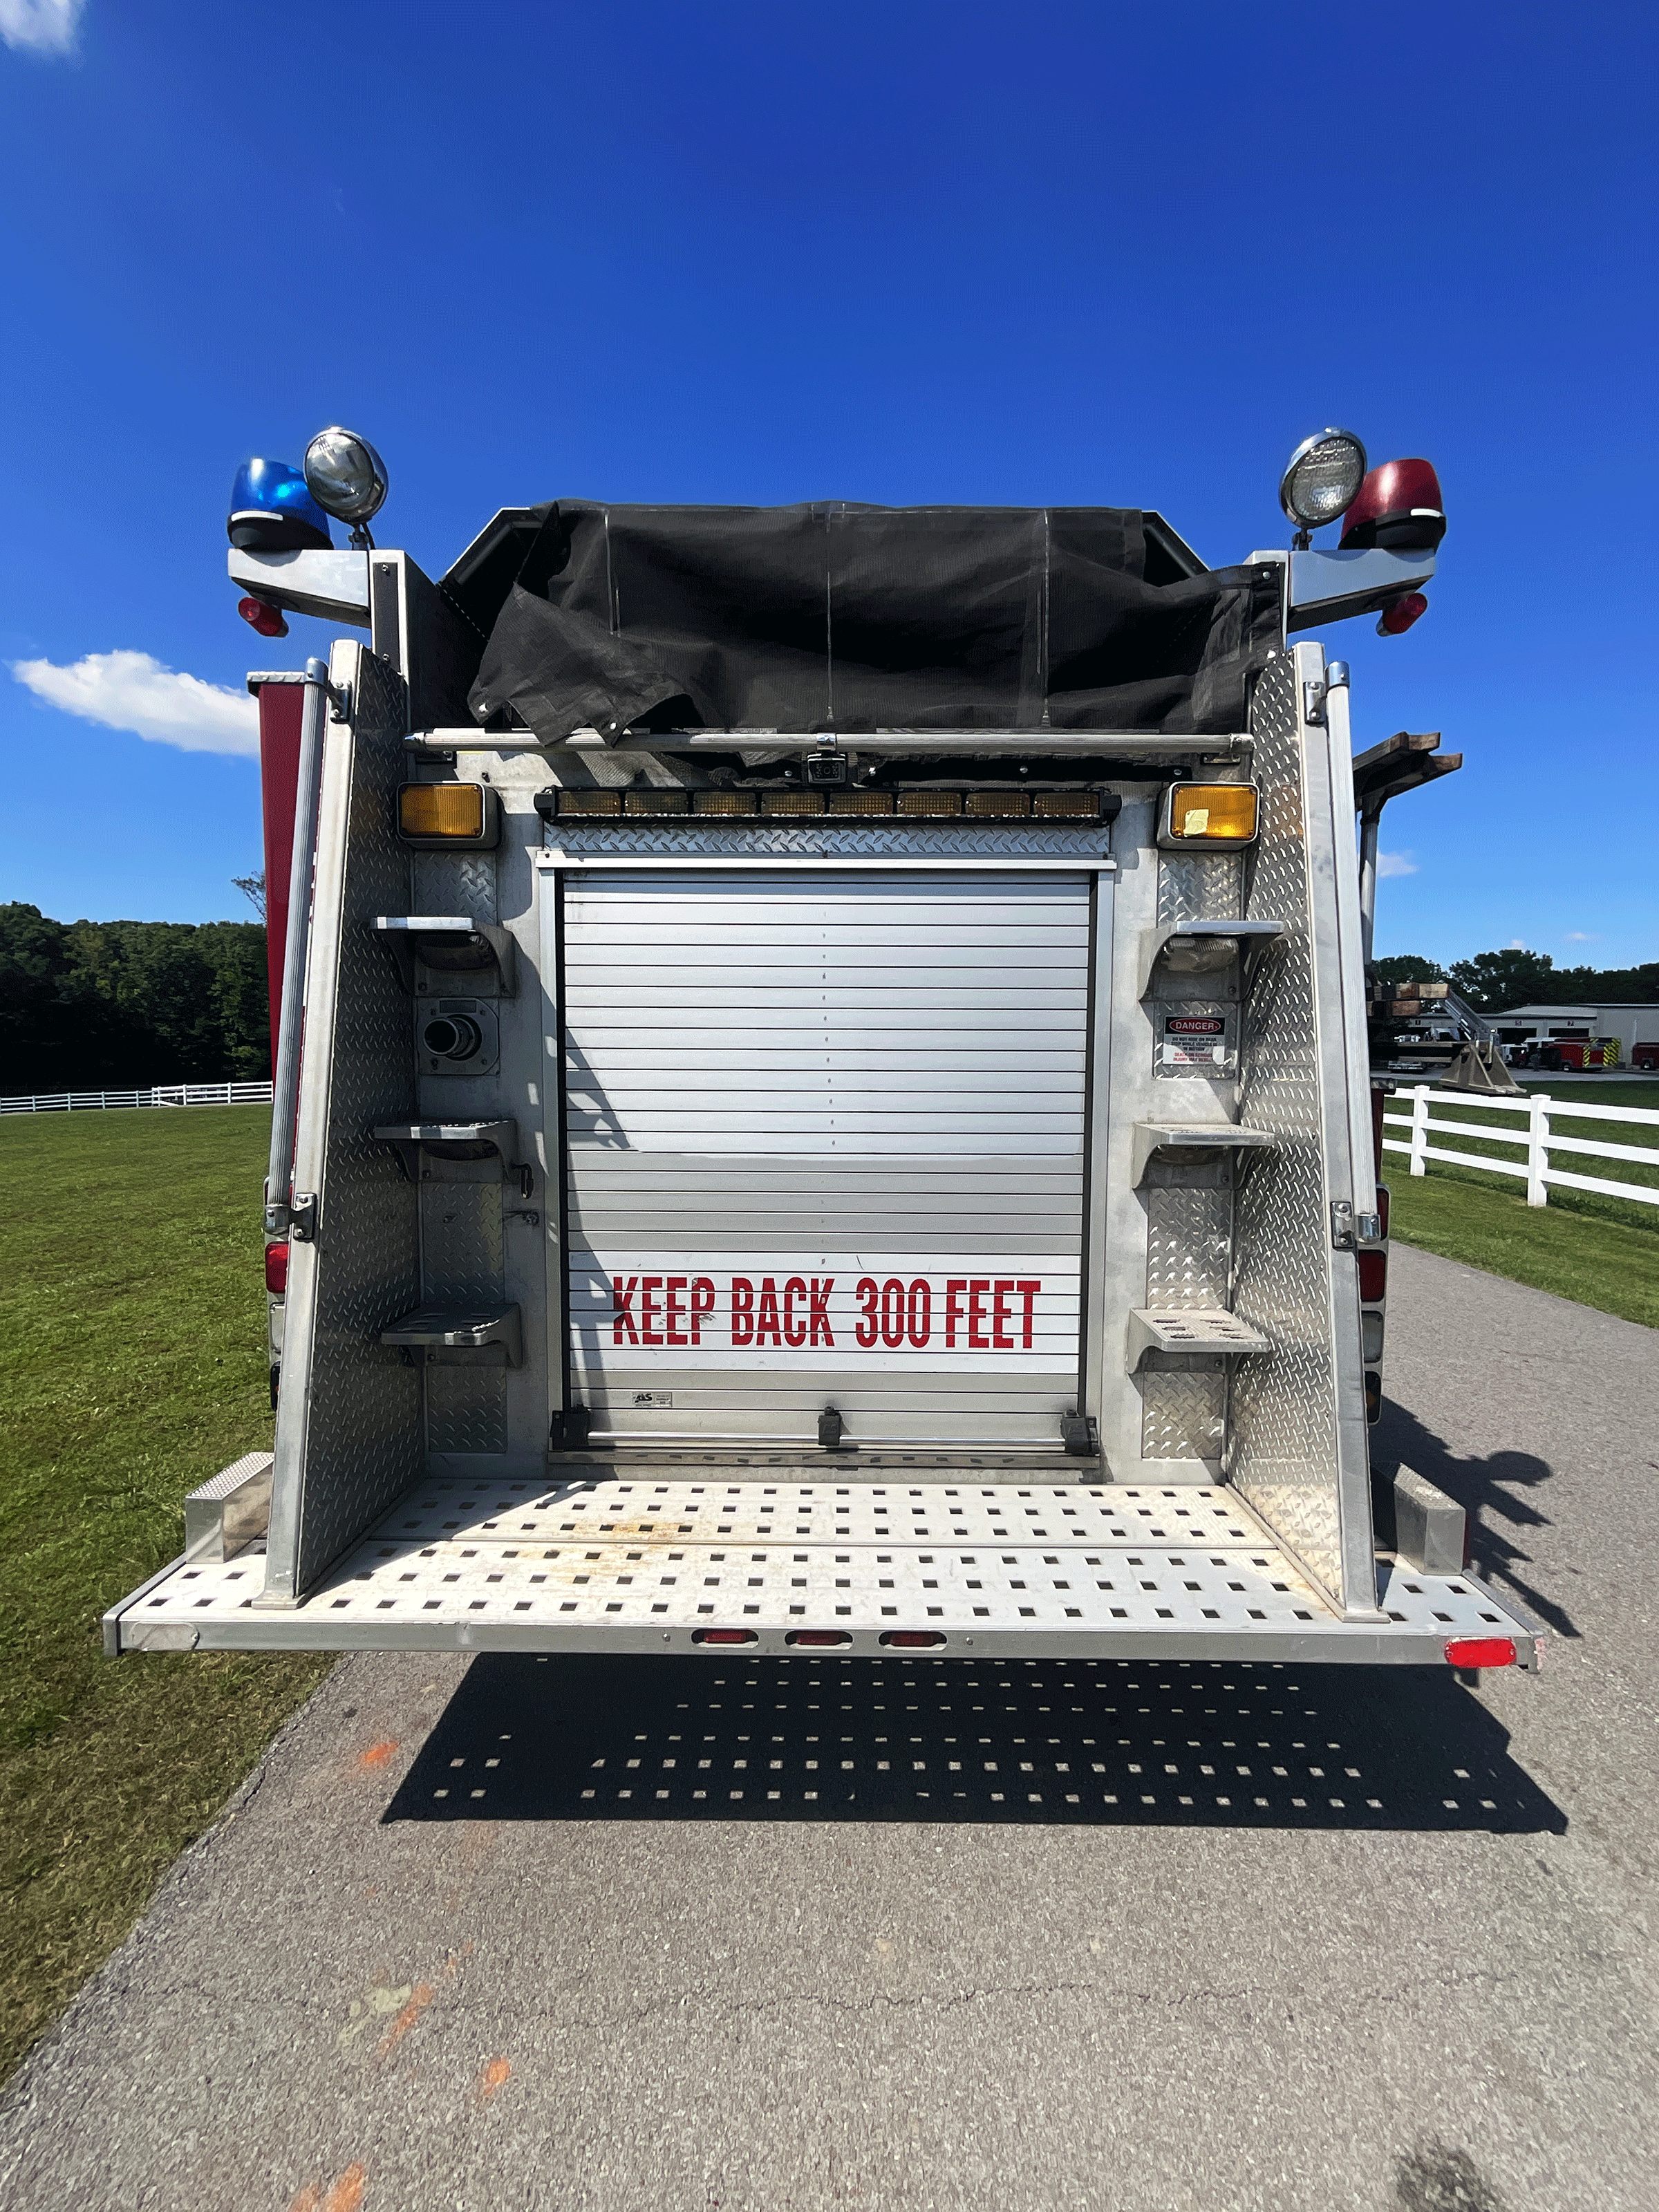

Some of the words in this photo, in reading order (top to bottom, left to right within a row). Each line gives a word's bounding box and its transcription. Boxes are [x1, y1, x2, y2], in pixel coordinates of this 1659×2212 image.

[1175, 1022, 1215, 1030] DANGER
[613, 1277, 715, 1345] KEEP
[731, 1277, 835, 1347] BACK
[856, 1277, 930, 1348] 300
[946, 1280, 1041, 1349] FEET
